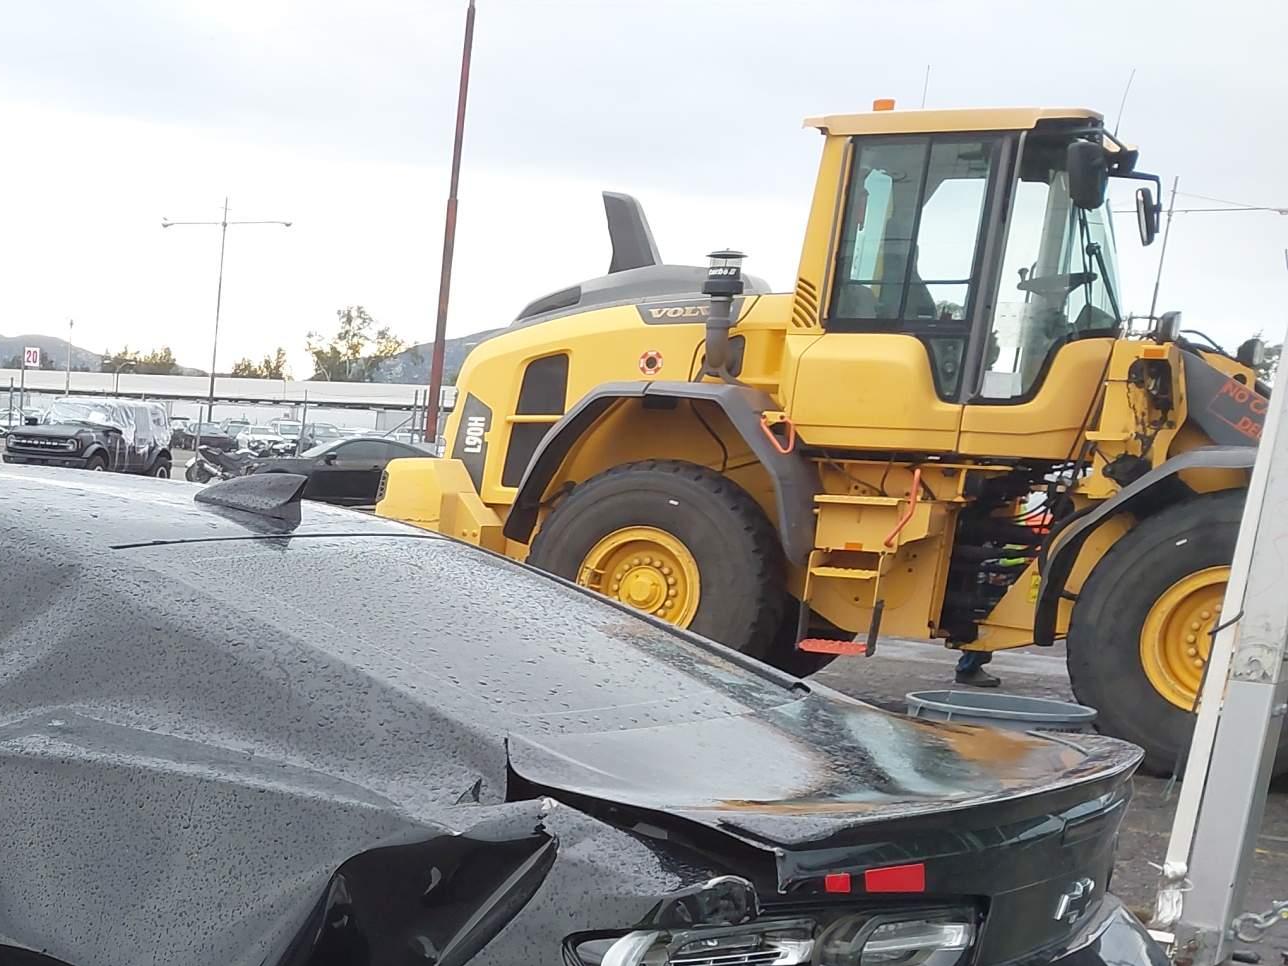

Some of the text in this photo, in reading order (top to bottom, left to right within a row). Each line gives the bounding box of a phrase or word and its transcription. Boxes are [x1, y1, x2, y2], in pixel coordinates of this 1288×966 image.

[648, 305, 712, 319] VOLV
[26, 350, 38, 364] 20
[463, 416, 486, 453] L90H
